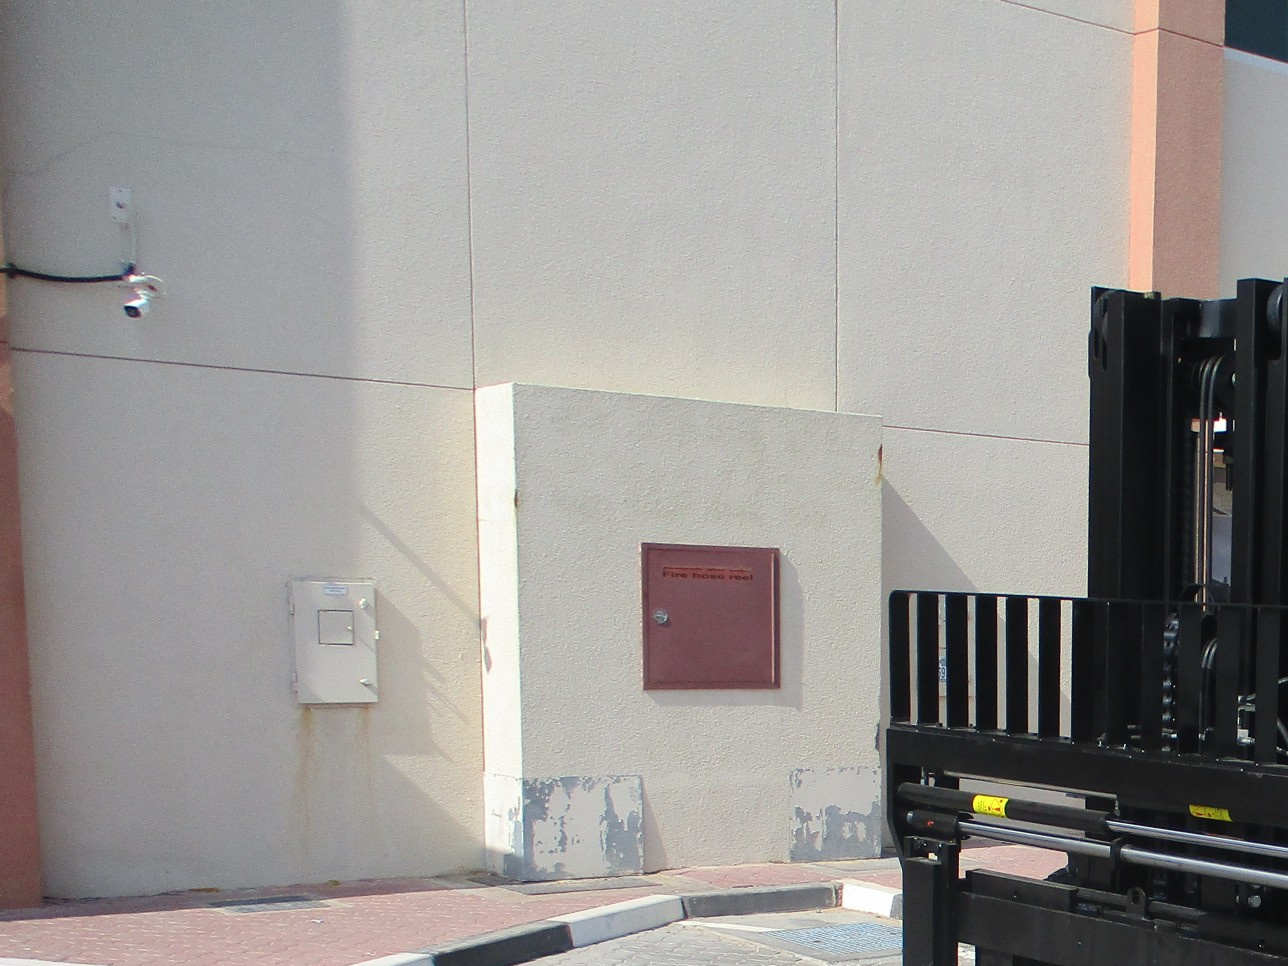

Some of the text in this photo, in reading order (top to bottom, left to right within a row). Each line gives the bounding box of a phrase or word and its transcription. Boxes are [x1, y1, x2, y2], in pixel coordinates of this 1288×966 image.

[662, 570, 753, 581] Fire hose reel
